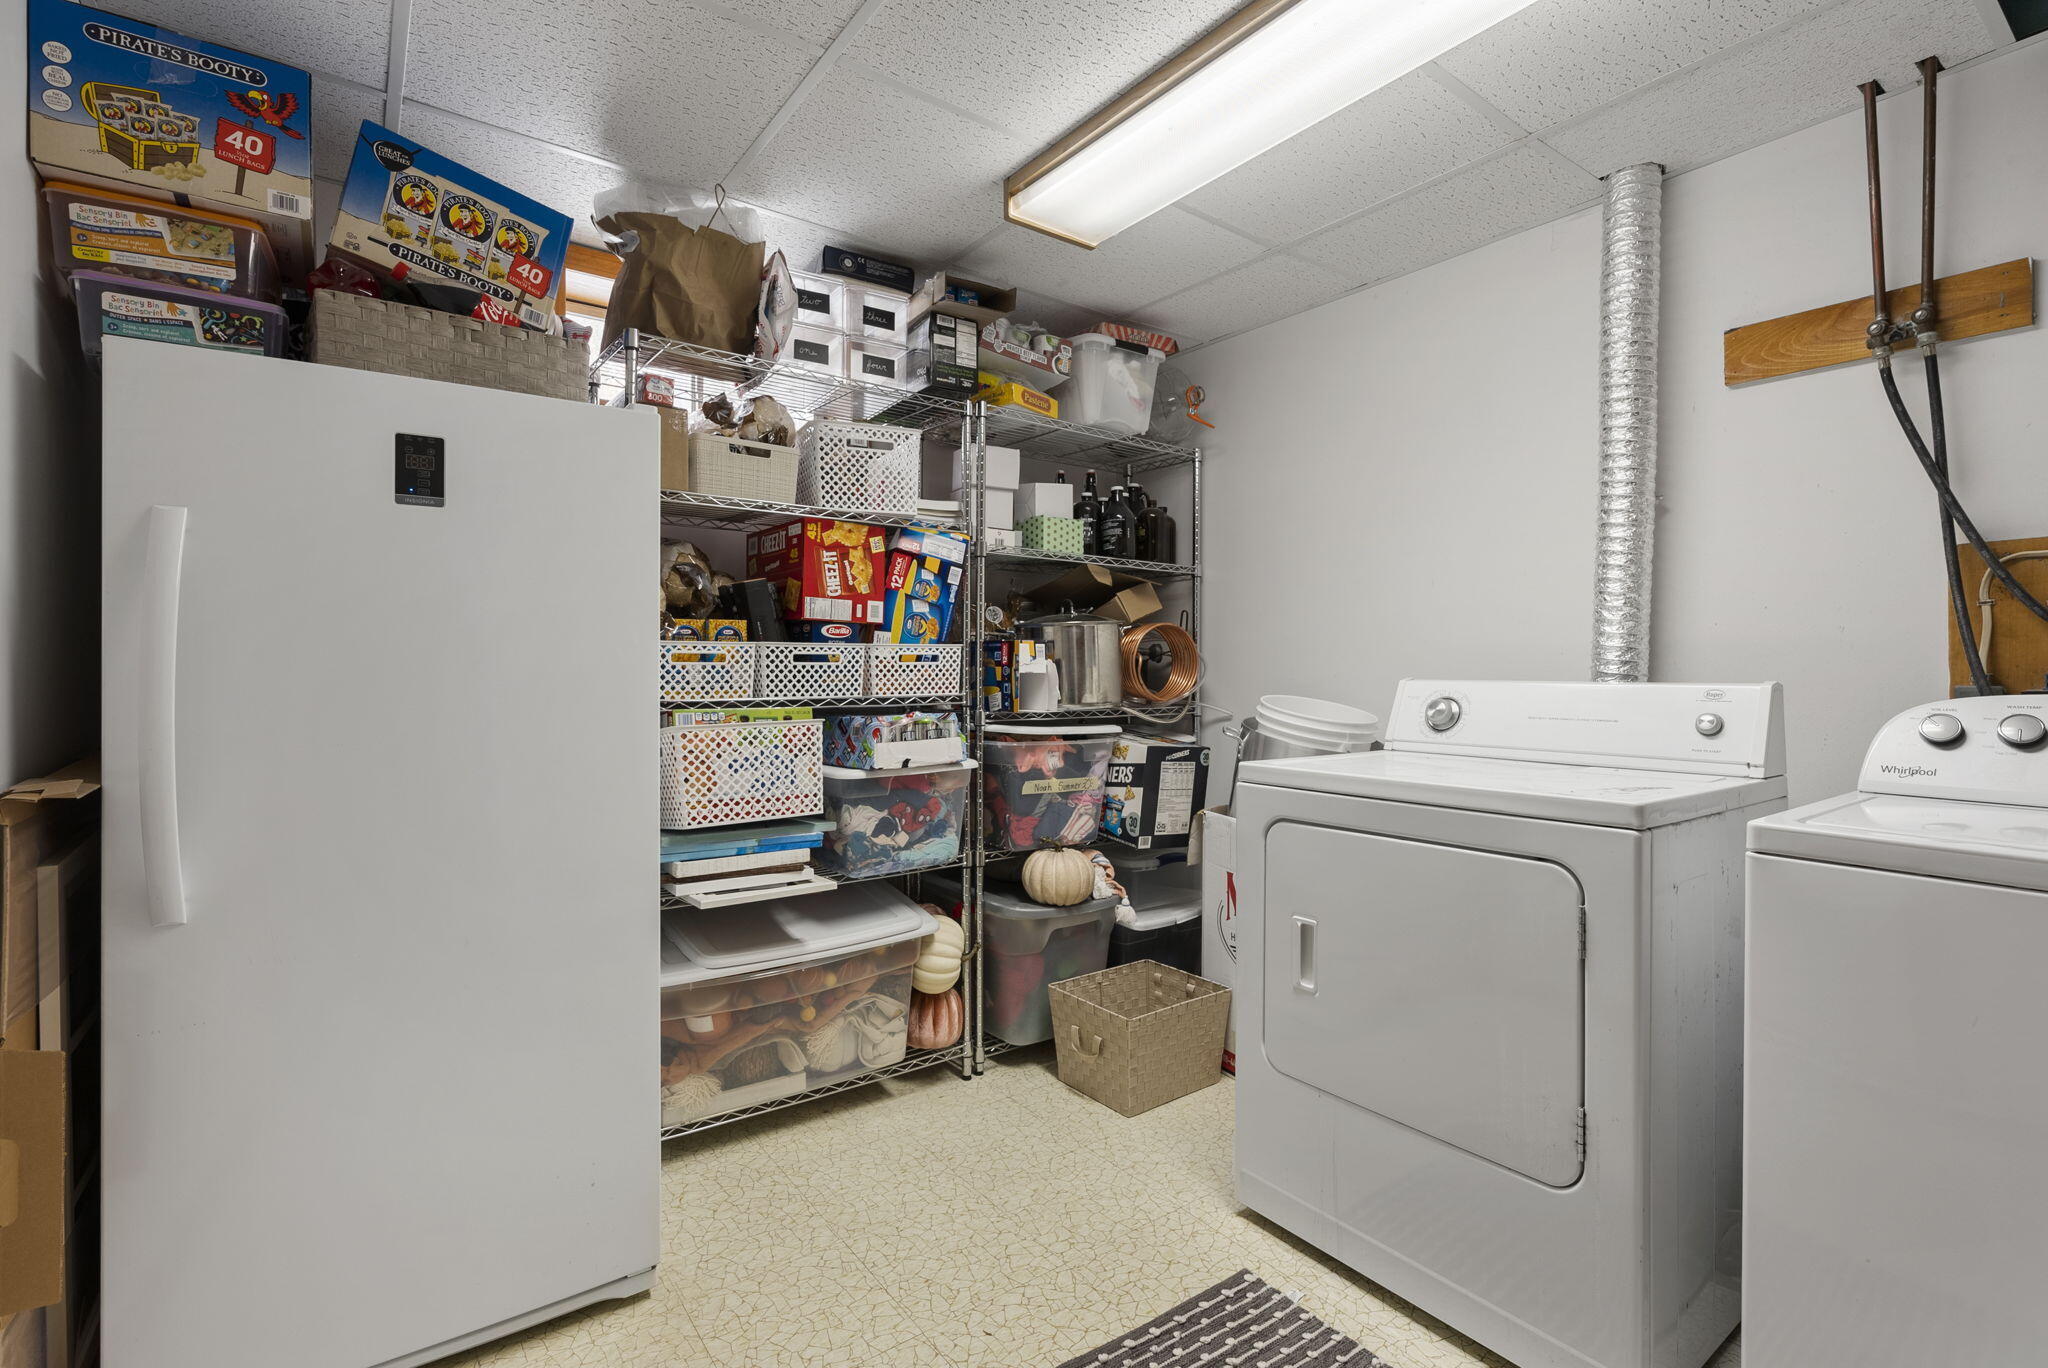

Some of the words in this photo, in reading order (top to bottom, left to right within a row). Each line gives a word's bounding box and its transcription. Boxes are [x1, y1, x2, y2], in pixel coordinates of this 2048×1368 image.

[99, 28, 181, 62] PIRATE'S
[188, 52, 253, 82] BOOTY
[225, 130, 263, 155] 40
[378, 145, 401, 157] GREAT
[218, 150, 244, 163] LUNCH
[246, 160, 265, 170] BAGS
[378, 151, 411, 166] LUNCHES
[396, 175, 425, 187] PIRATE'S
[76, 212, 92, 222] Bac
[79, 206, 113, 219] Sensory
[115, 211, 128, 220] Bin
[444, 196, 474, 208] PIRATE'S
[475, 202, 493, 229] BOOTY
[520, 225, 534, 248] BOOTY
[399, 246, 456, 278] PIRATE'S
[460, 272, 505, 299] BOOTY
[516, 263, 544, 285] 40
[509, 275, 528, 288] LUNCH
[108, 302, 123, 311] Bac
[111, 294, 145, 308] Sensory
[147, 301, 160, 309] Bin
[801, 294, 822, 305] two
[109, 312, 126, 320] OUTER
[865, 312, 887, 324] three
[800, 347, 818, 356] one
[866, 360, 887, 372] four
[1024, 392, 1049, 409] Pastene
[806, 523, 817, 540] 45
[893, 557, 903, 575] PACK
[890, 577, 904, 589] 12
[828, 627, 850, 636] Barilla
[1881, 764, 1937, 778] Whirlpool
[1034, 782, 1053, 792] Noah
[1128, 815, 1137, 829] 30
